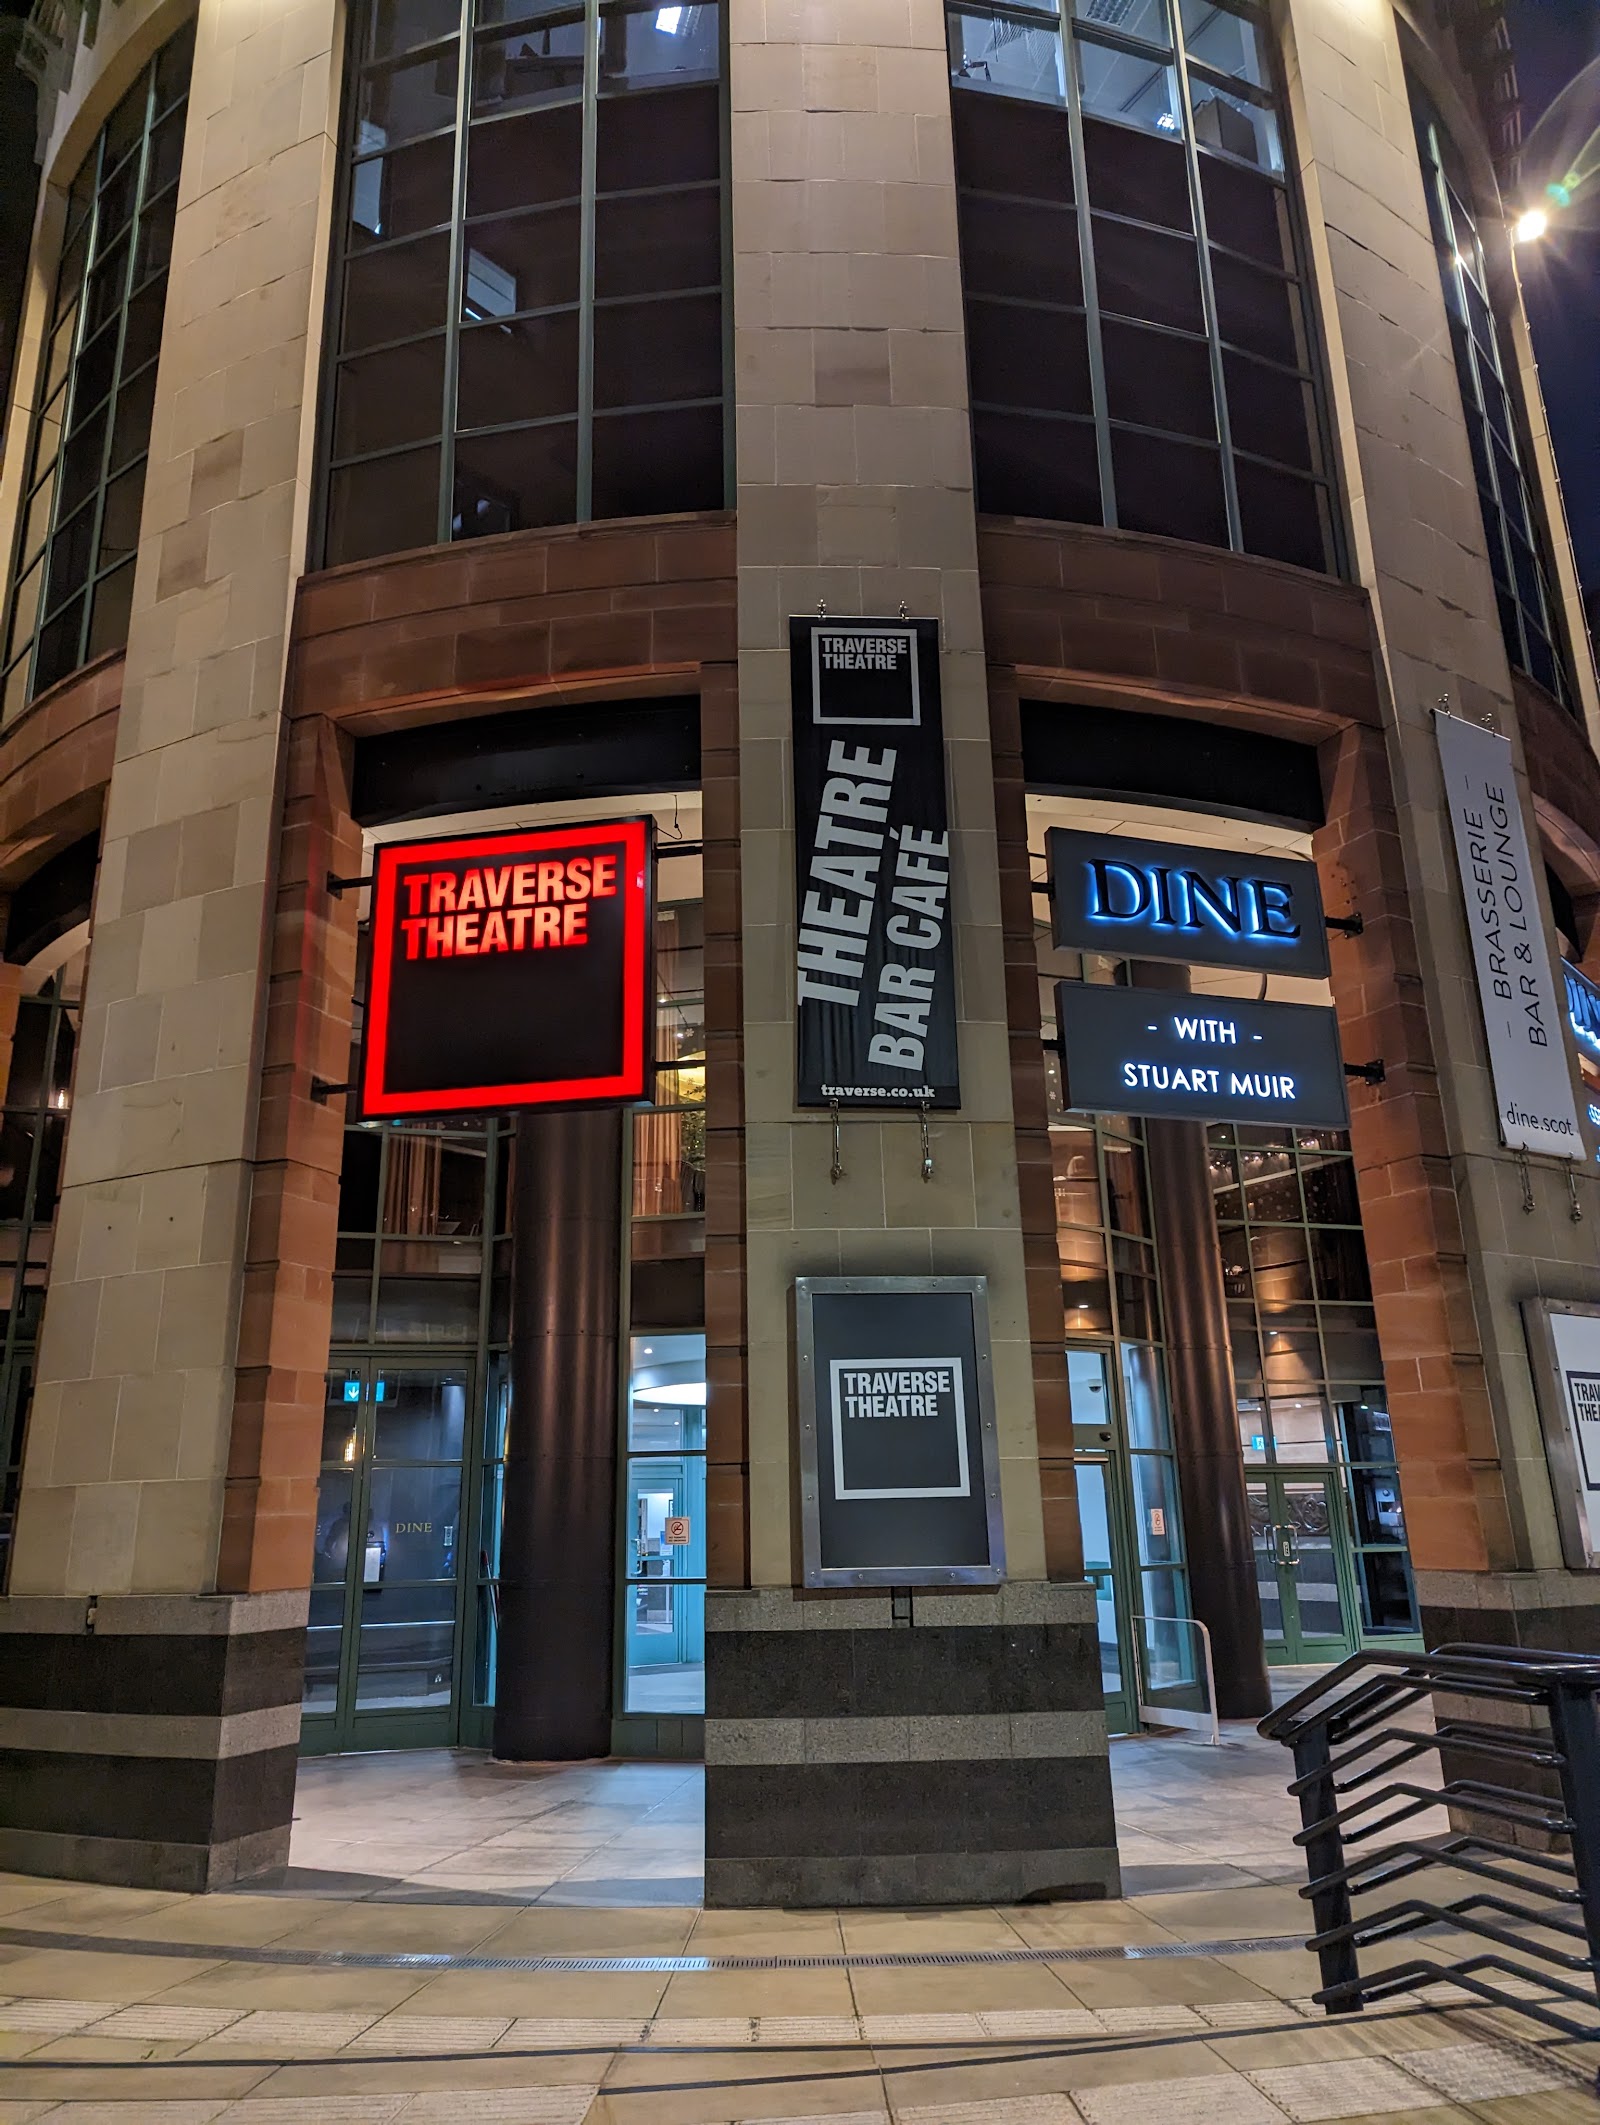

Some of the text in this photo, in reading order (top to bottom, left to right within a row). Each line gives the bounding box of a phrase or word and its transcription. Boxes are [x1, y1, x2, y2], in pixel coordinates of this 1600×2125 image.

[822, 637, 907, 654] TRAVERSE
[823, 654, 897, 670] THEATRE
[403, 855, 617, 915] TRAVERSE
[797, 739, 897, 1007] THEATRE
[1088, 858, 1301, 939] DINE
[1464, 808, 1512, 999] BRASSERIE
[1485, 782, 1547, 1047] BAR & LOUNGE
[401, 903, 588, 961] THEATRE
[868, 963, 936, 1071] BAR
[1174, 1016, 1237, 1044] WITH
[821, 1084, 936, 1098] traverse.co.uk
[1124, 1062, 1296, 1099] STUART MUIR
[1507, 1102, 1574, 1136] dine.scot
[843, 1371, 951, 1395] TRAVERSE
[844, 1395, 938, 1418] THEATRE
[396, 1523, 432, 1533] DINE
